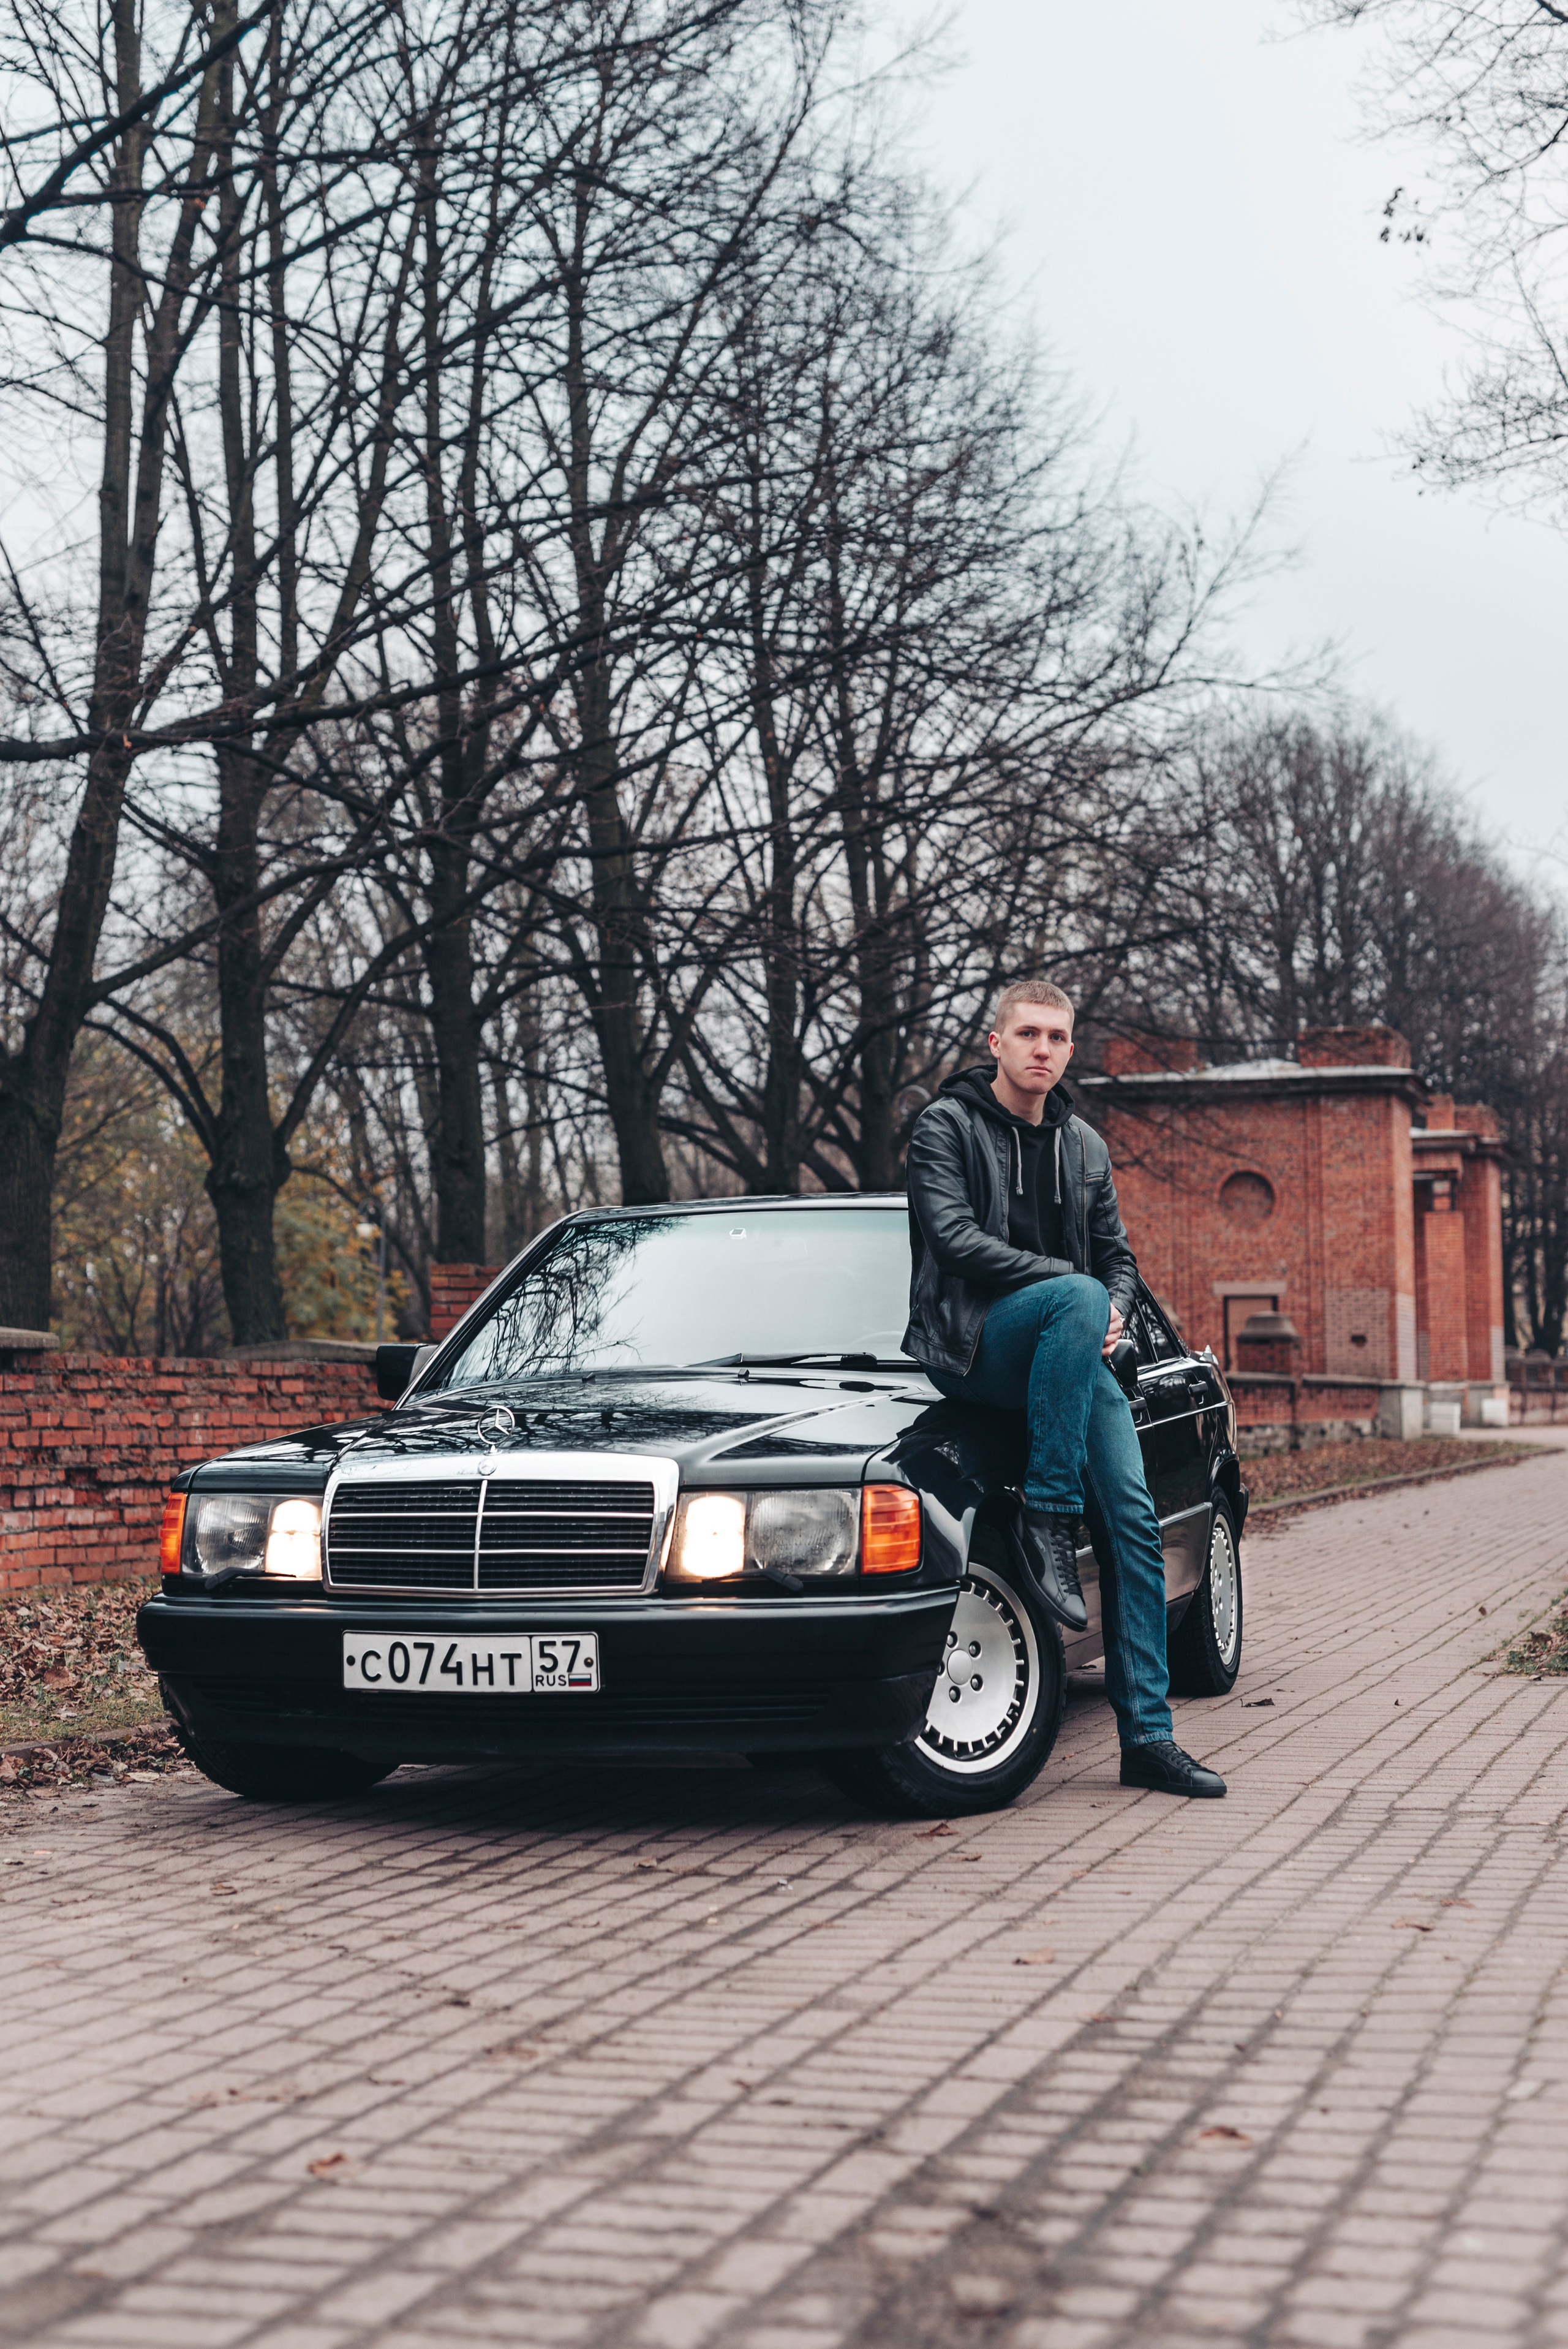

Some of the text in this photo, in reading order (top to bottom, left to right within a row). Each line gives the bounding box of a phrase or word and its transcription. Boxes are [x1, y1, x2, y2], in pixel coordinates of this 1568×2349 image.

[361, 1641, 522, 1686] C074HT
[538, 1640, 581, 1673] 57
[535, 1674, 567, 1687] RUS
